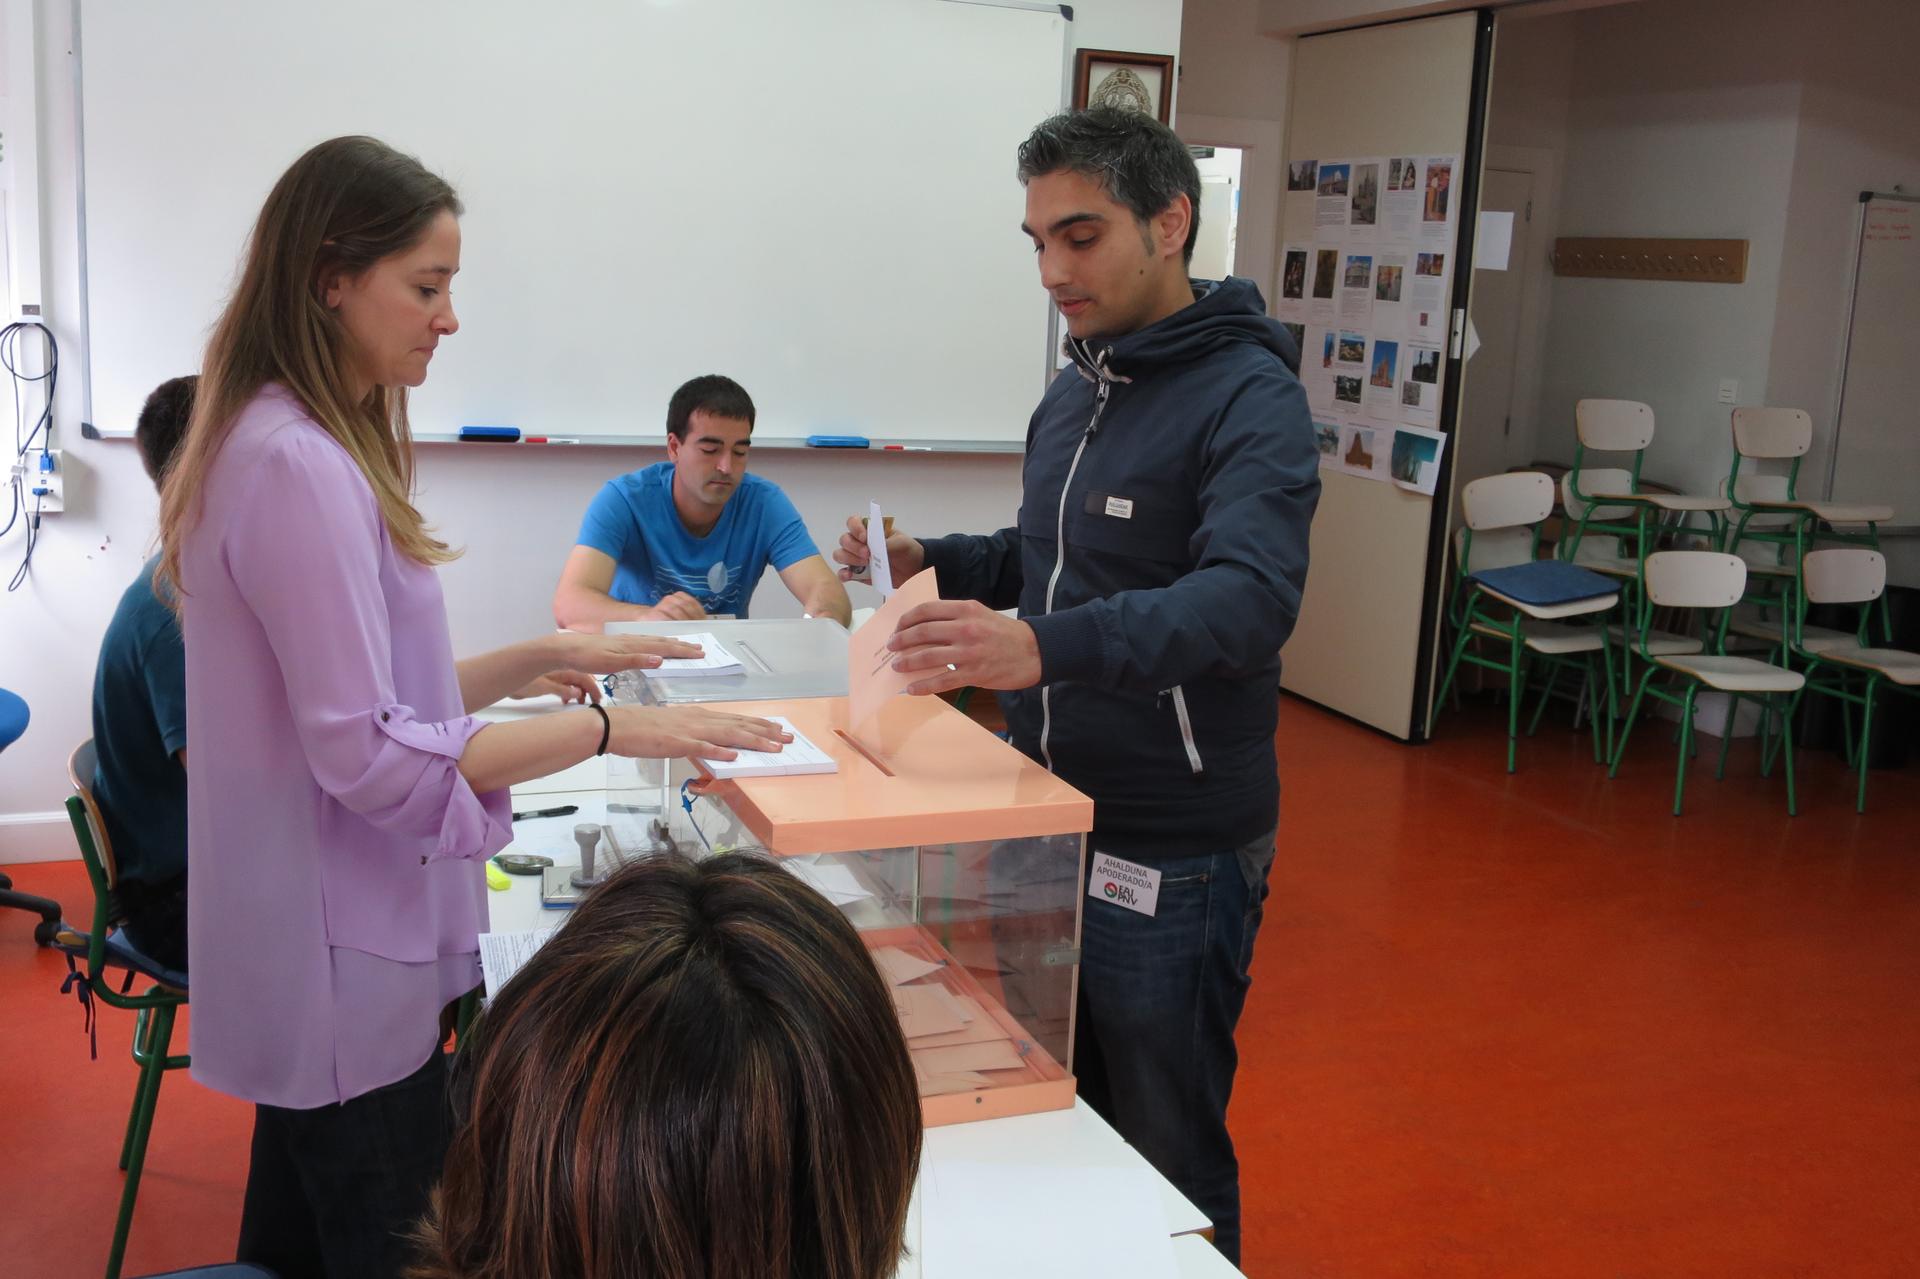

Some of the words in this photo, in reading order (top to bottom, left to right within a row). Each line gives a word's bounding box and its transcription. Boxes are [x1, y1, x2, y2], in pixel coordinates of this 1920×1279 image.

[1104, 858, 1148, 878] AHALDUNA
[1096, 866, 1153, 890] APODERADO/A
[1119, 885, 1134, 897] EAJ
[1118, 894, 1138, 905] PNV
